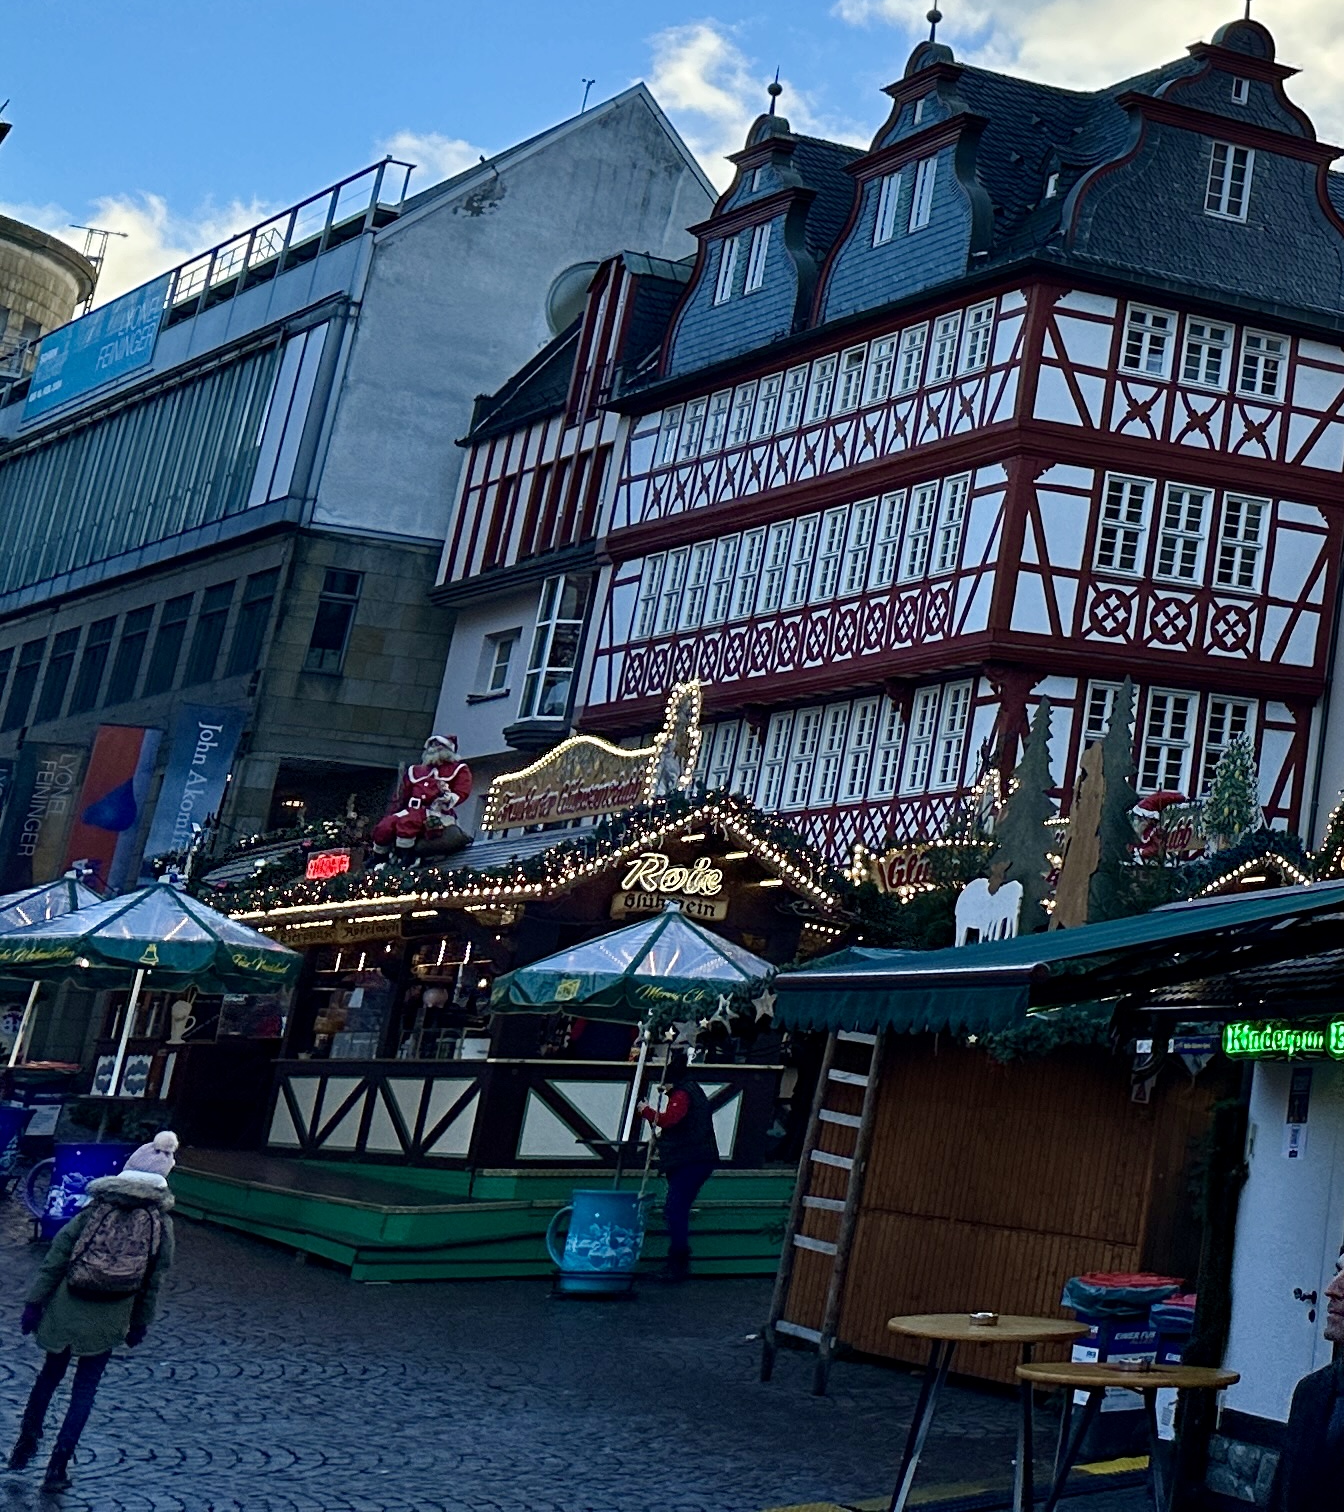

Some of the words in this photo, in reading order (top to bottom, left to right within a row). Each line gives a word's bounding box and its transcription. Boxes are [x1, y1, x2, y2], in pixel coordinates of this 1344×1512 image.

[192, 721, 224, 766] John
[17, 759, 58, 857] FEININGER
[621, 852, 724, 896] Rote
